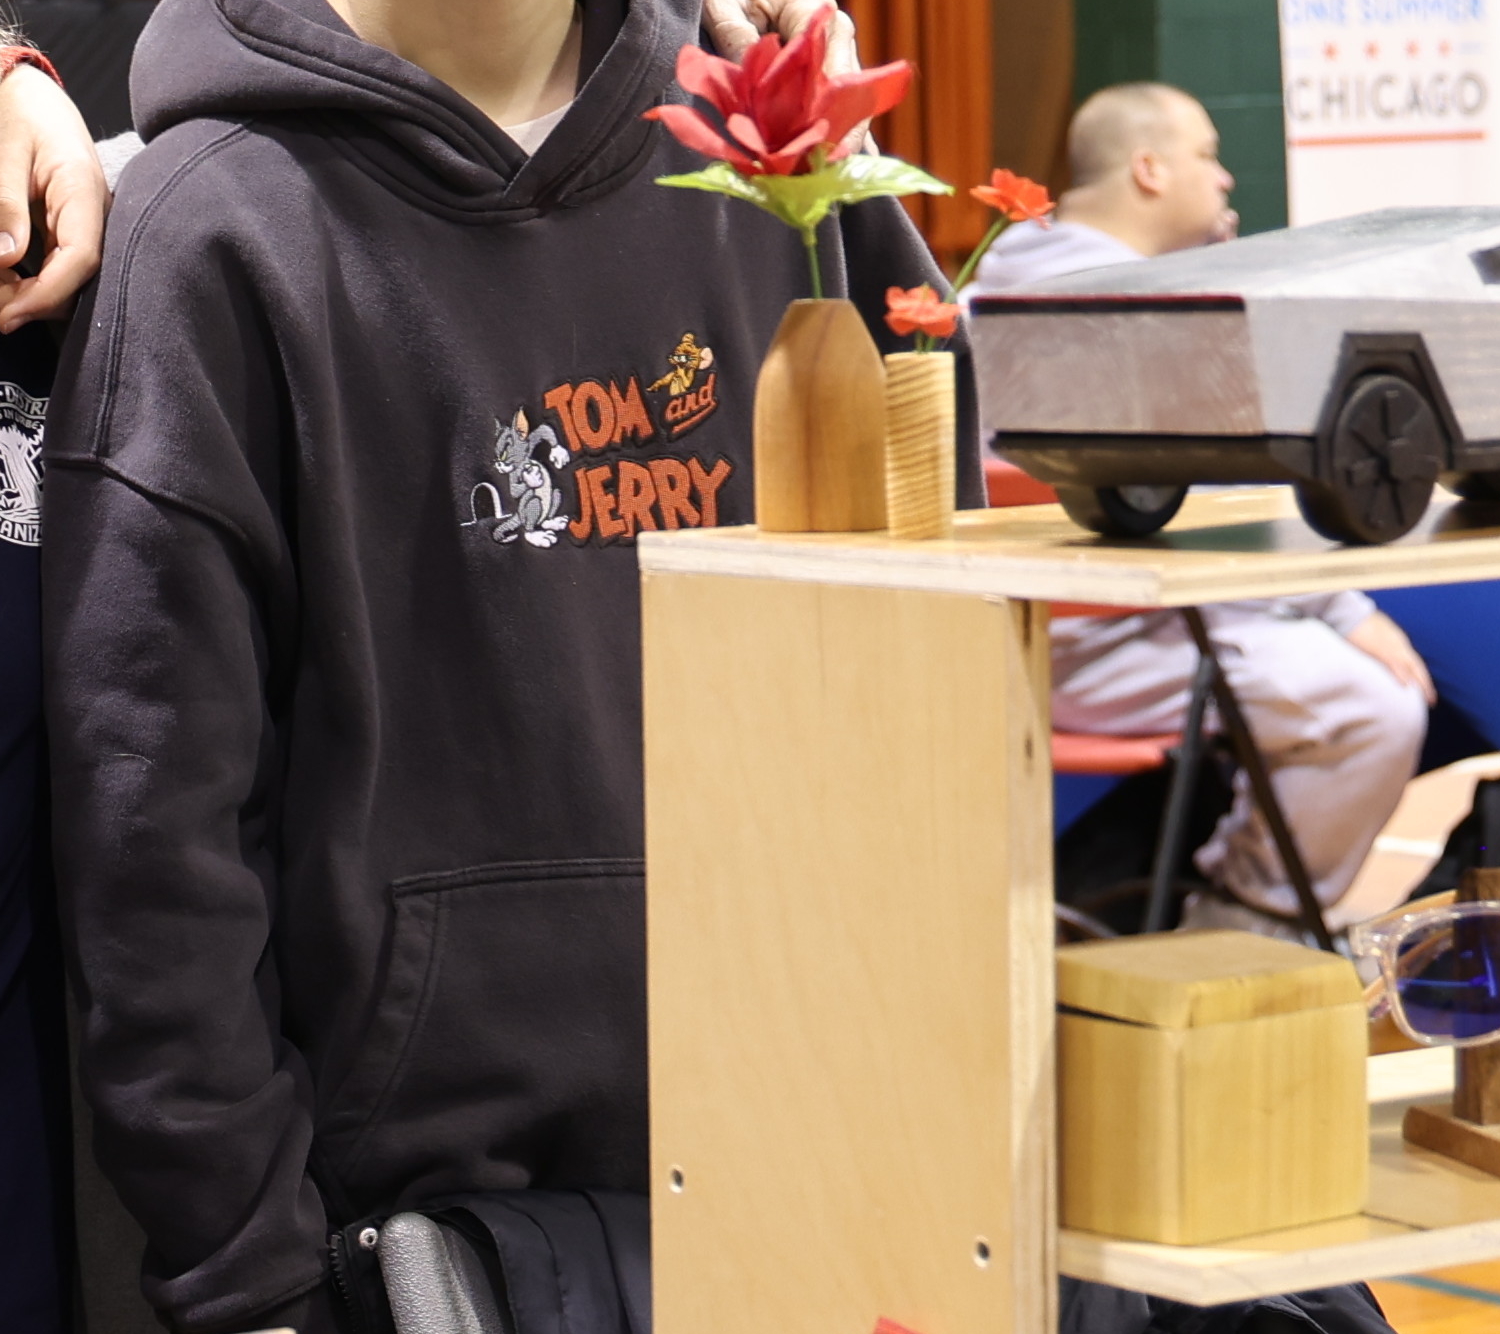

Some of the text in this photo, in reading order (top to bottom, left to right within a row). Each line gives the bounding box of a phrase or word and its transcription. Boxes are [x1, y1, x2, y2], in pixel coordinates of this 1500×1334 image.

[1286, 71, 1488, 121] CHICAGO
[4, 385, 49, 415] DISTRI
[544, 371, 718, 452] TOM and
[569, 457, 732, 540] JERRY
